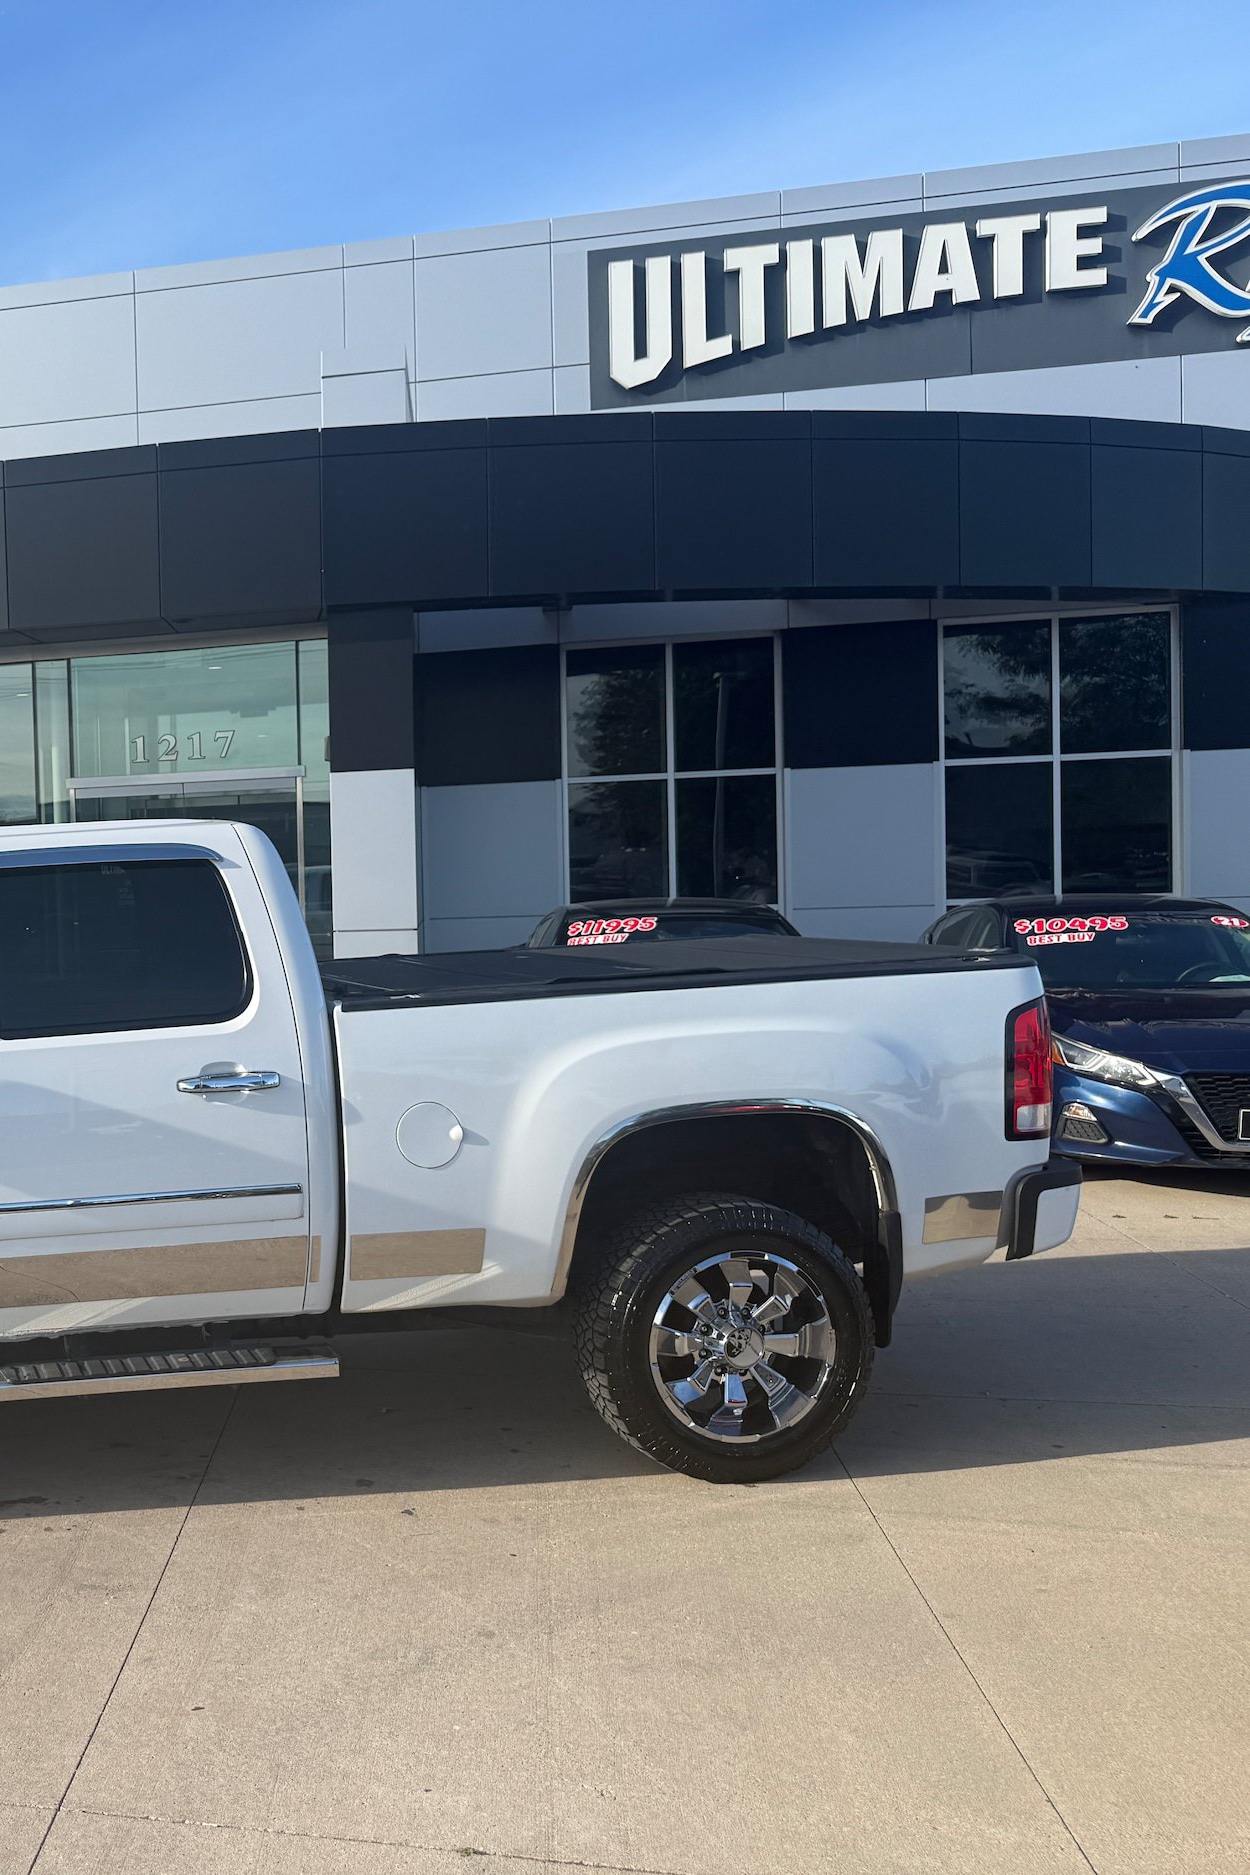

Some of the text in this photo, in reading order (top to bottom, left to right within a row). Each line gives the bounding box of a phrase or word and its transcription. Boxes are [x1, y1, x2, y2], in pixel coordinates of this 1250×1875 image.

[608, 179, 1250, 389] ULTIMATE R
[131, 729, 236, 764] 1217
[567, 917, 657, 936] $11995
[1014, 916, 1128, 934] $10495
[567, 933, 629, 946] BEST BUY
[1027, 932, 1095, 945] BEST BUY
